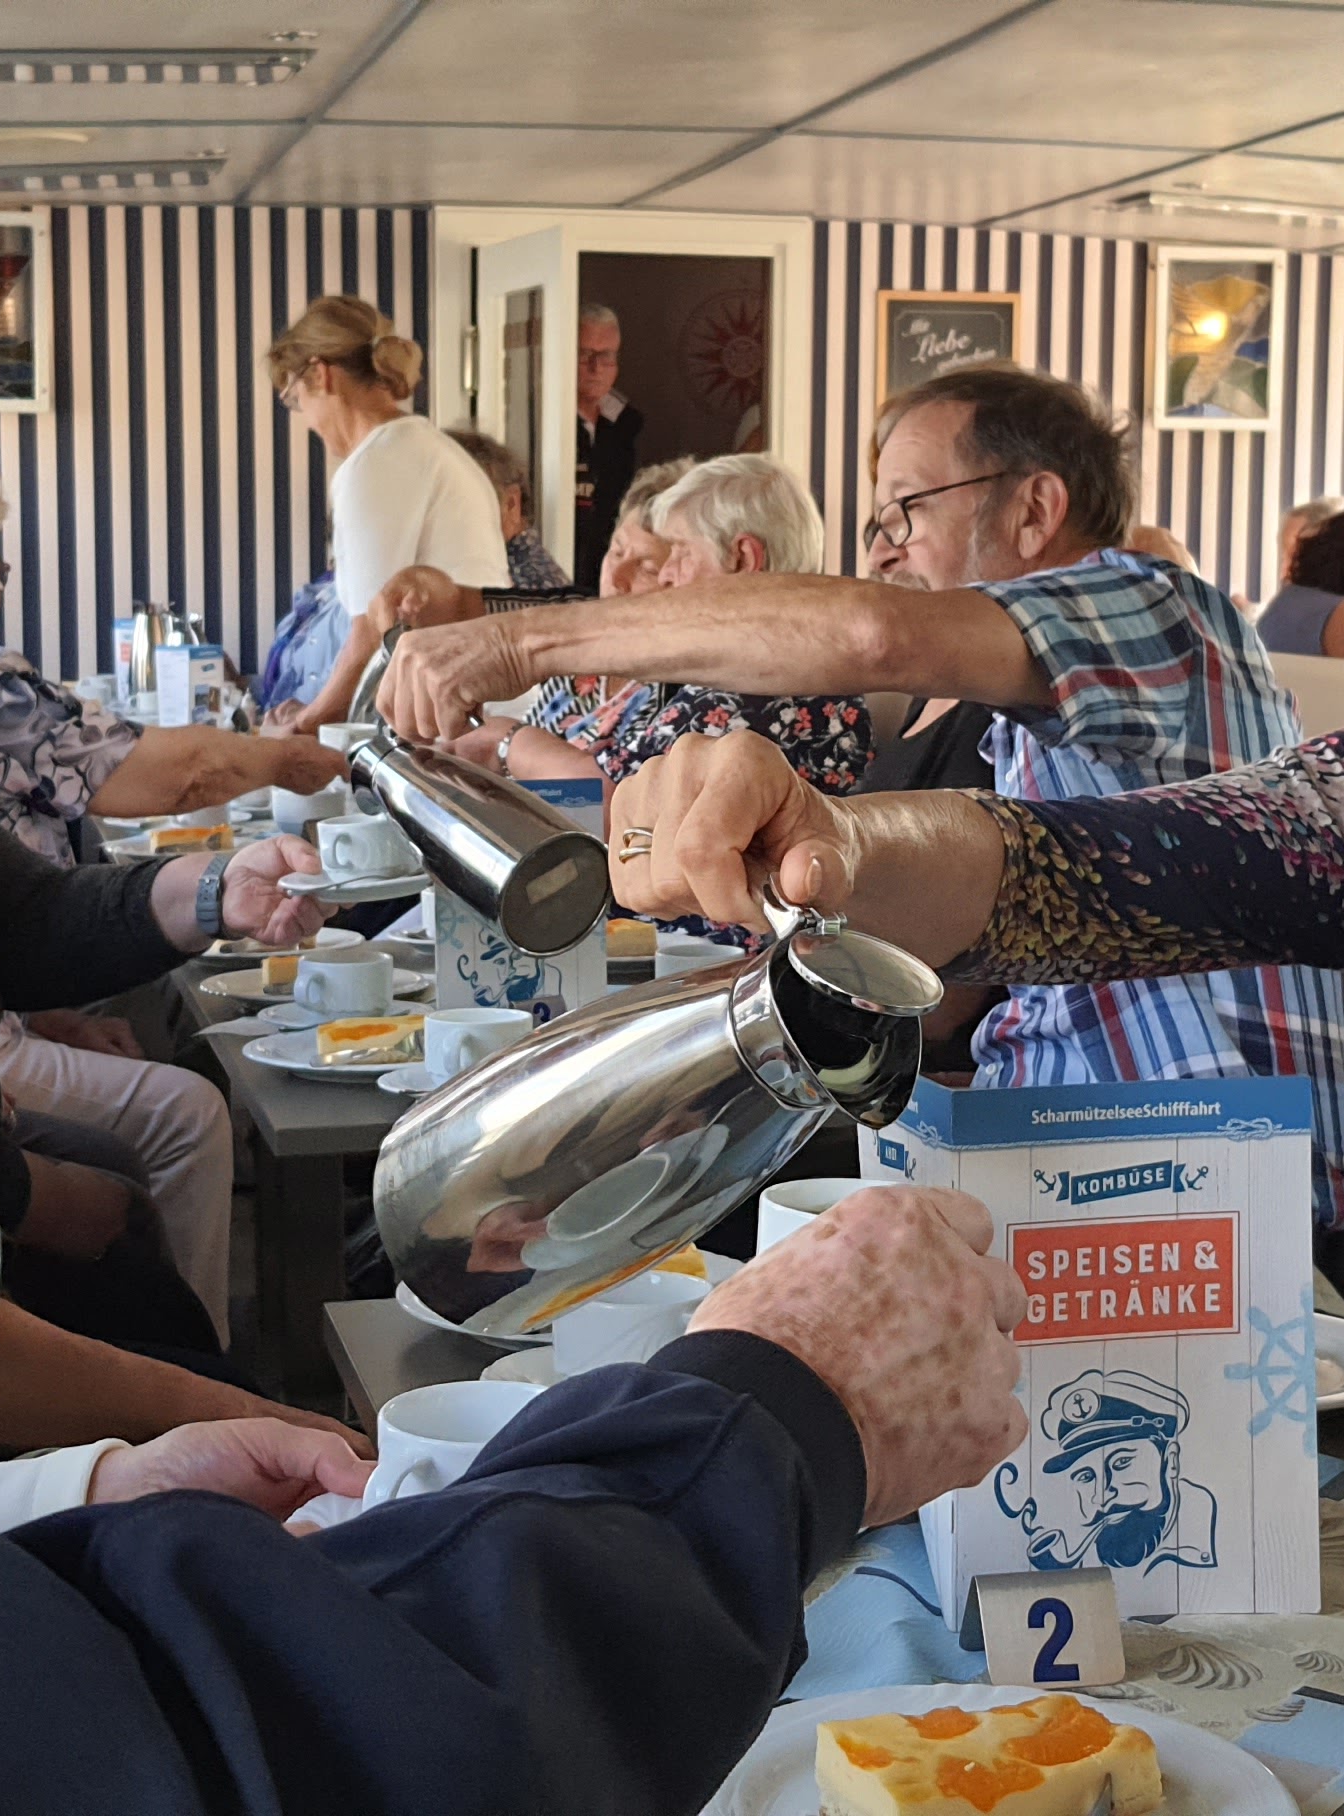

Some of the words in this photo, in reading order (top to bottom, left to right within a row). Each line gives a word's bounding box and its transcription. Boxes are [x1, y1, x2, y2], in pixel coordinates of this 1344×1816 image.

[1031, 1101, 1221, 1125] ScharmützelseeSchifffahrt
[1077, 1167, 1165, 1197] KOMBÜSE
[1027, 1241, 1180, 1280] SPEISEN
[1194, 1240, 1220, 1270] &
[1027, 1278, 1221, 1323] GETRÄNKE
[1027, 1597, 1081, 1683] 2
